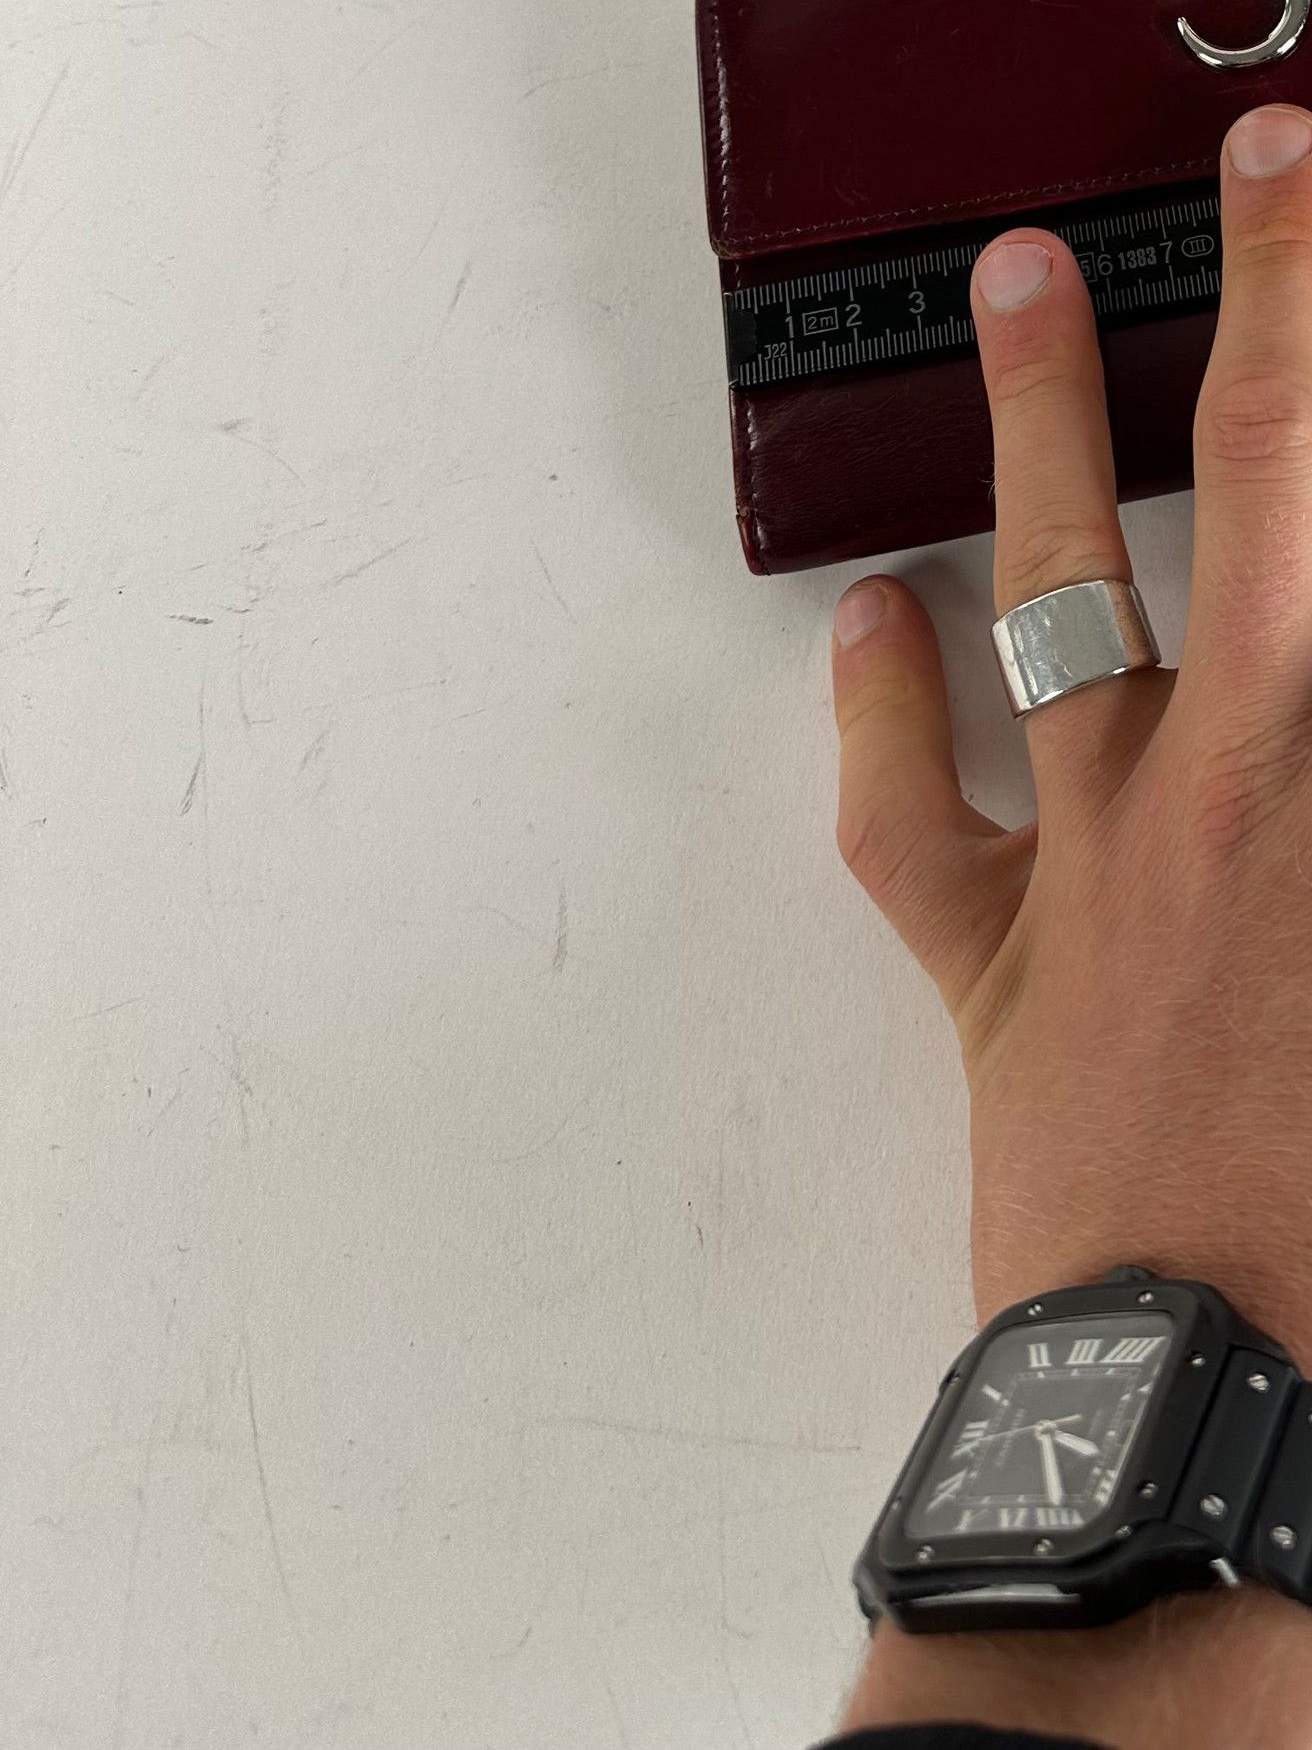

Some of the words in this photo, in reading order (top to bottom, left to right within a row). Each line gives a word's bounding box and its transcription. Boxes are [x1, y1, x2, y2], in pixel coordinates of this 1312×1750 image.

[785, 315, 795, 339] 1
[845, 303, 863, 327] 2
[908, 290, 927, 315] 3
[1097, 253, 1114, 276] 6
[1159, 241, 1173, 264] 7
